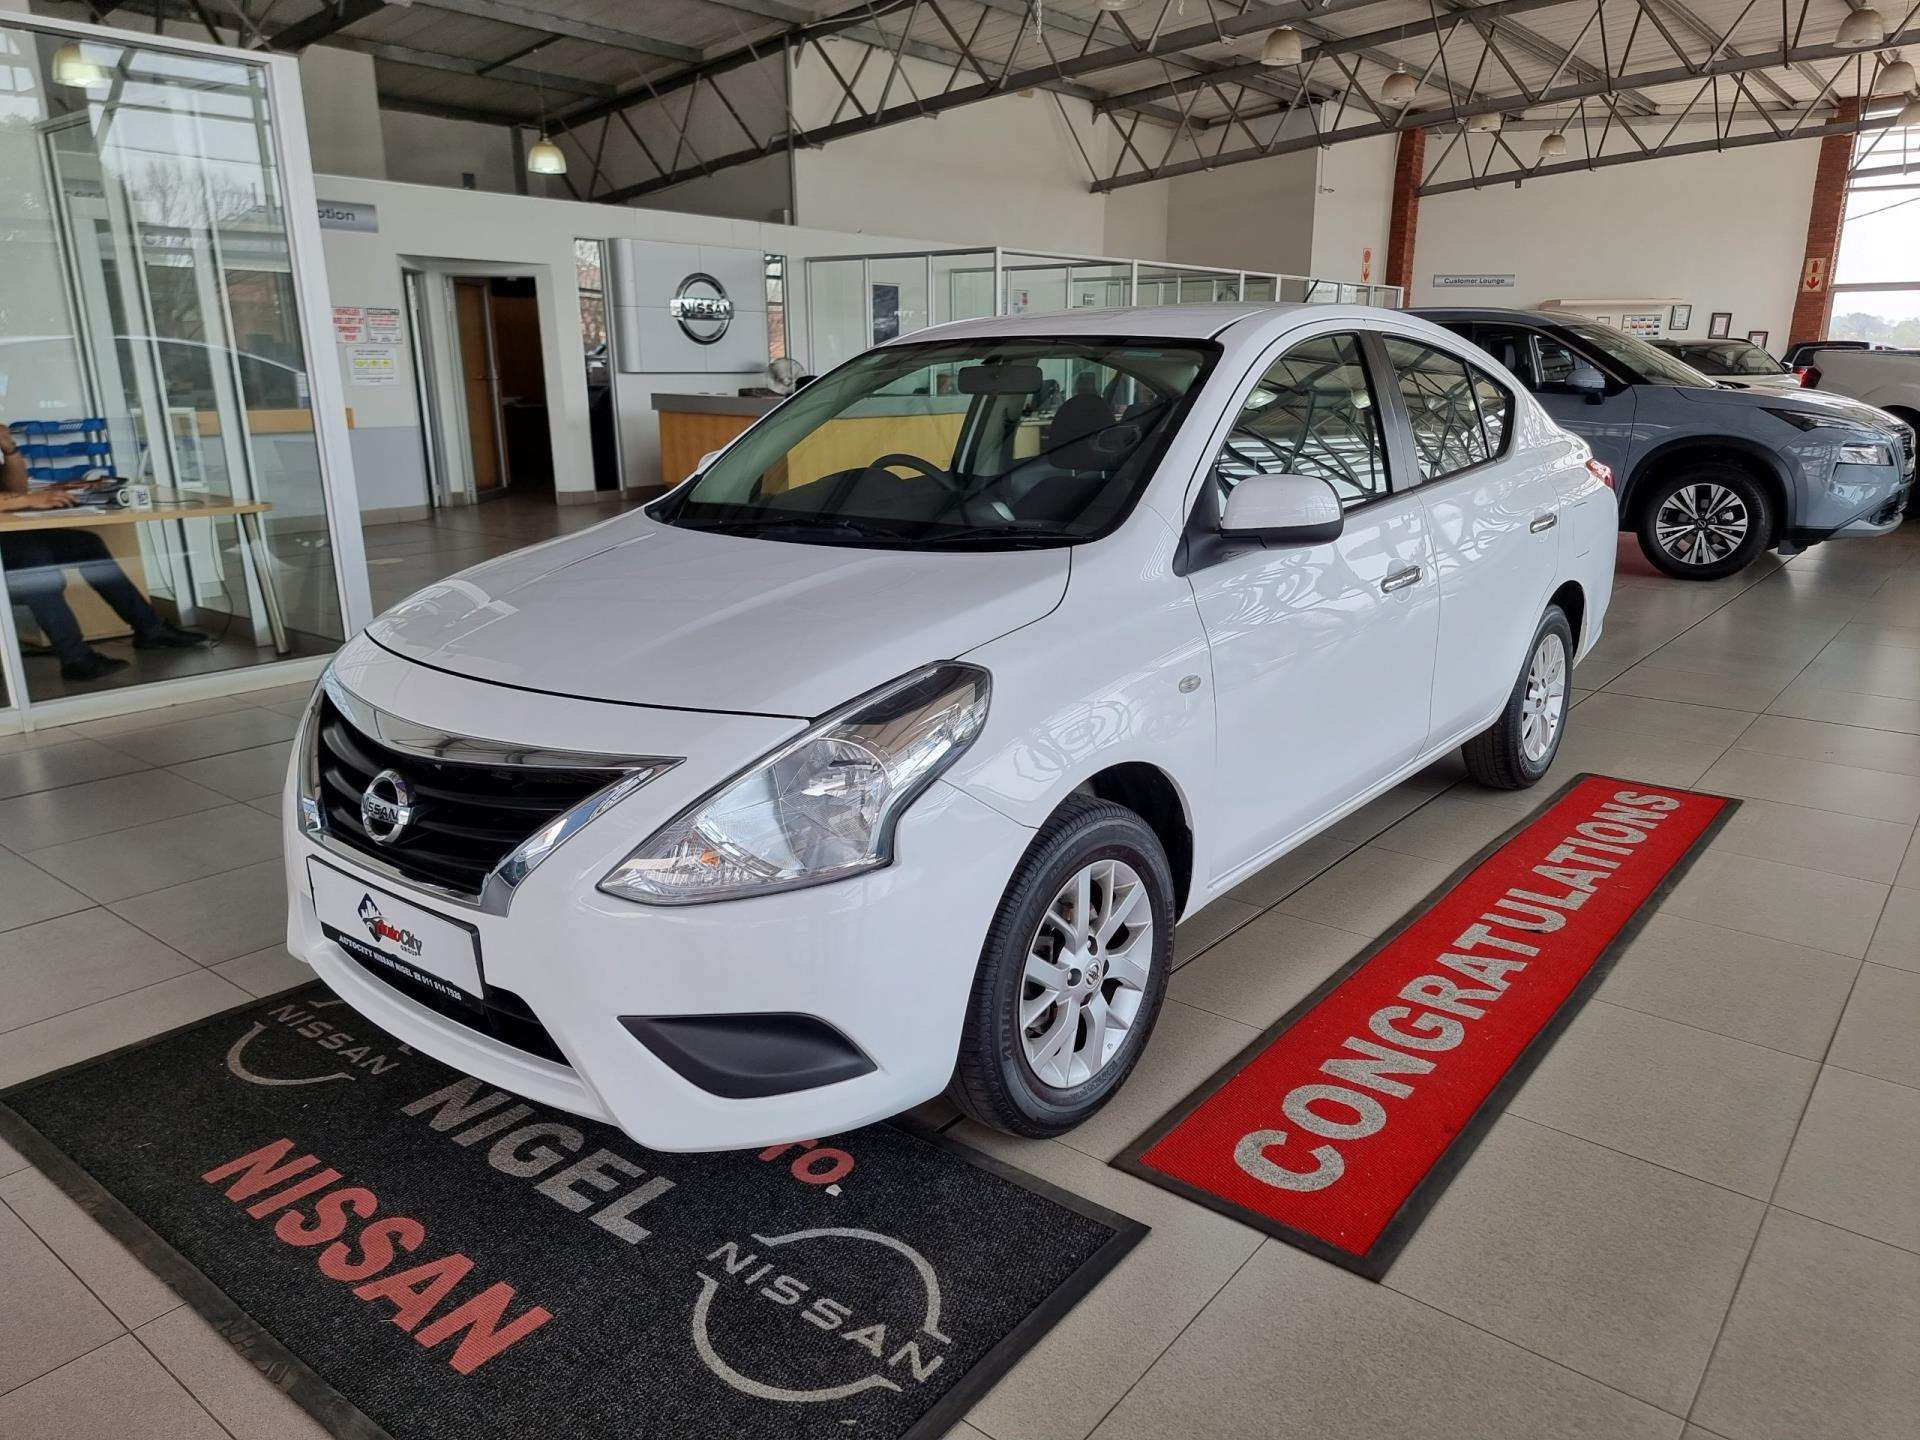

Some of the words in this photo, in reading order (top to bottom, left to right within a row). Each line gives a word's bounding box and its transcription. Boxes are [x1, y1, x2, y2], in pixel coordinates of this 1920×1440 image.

[680, 301, 733, 316] NISSAN
[1480, 277, 1505, 285] Lounge
[339, 934, 373, 957] AUTOCITY
[1233, 791, 1681, 1192] CONGRATULATIONS
[267, 1004, 400, 1075] NISSAN
[400, 1076, 678, 1244] NIGEL
[201, 1137, 554, 1376] NISSAN
[705, 1241, 945, 1382] NISSAN
